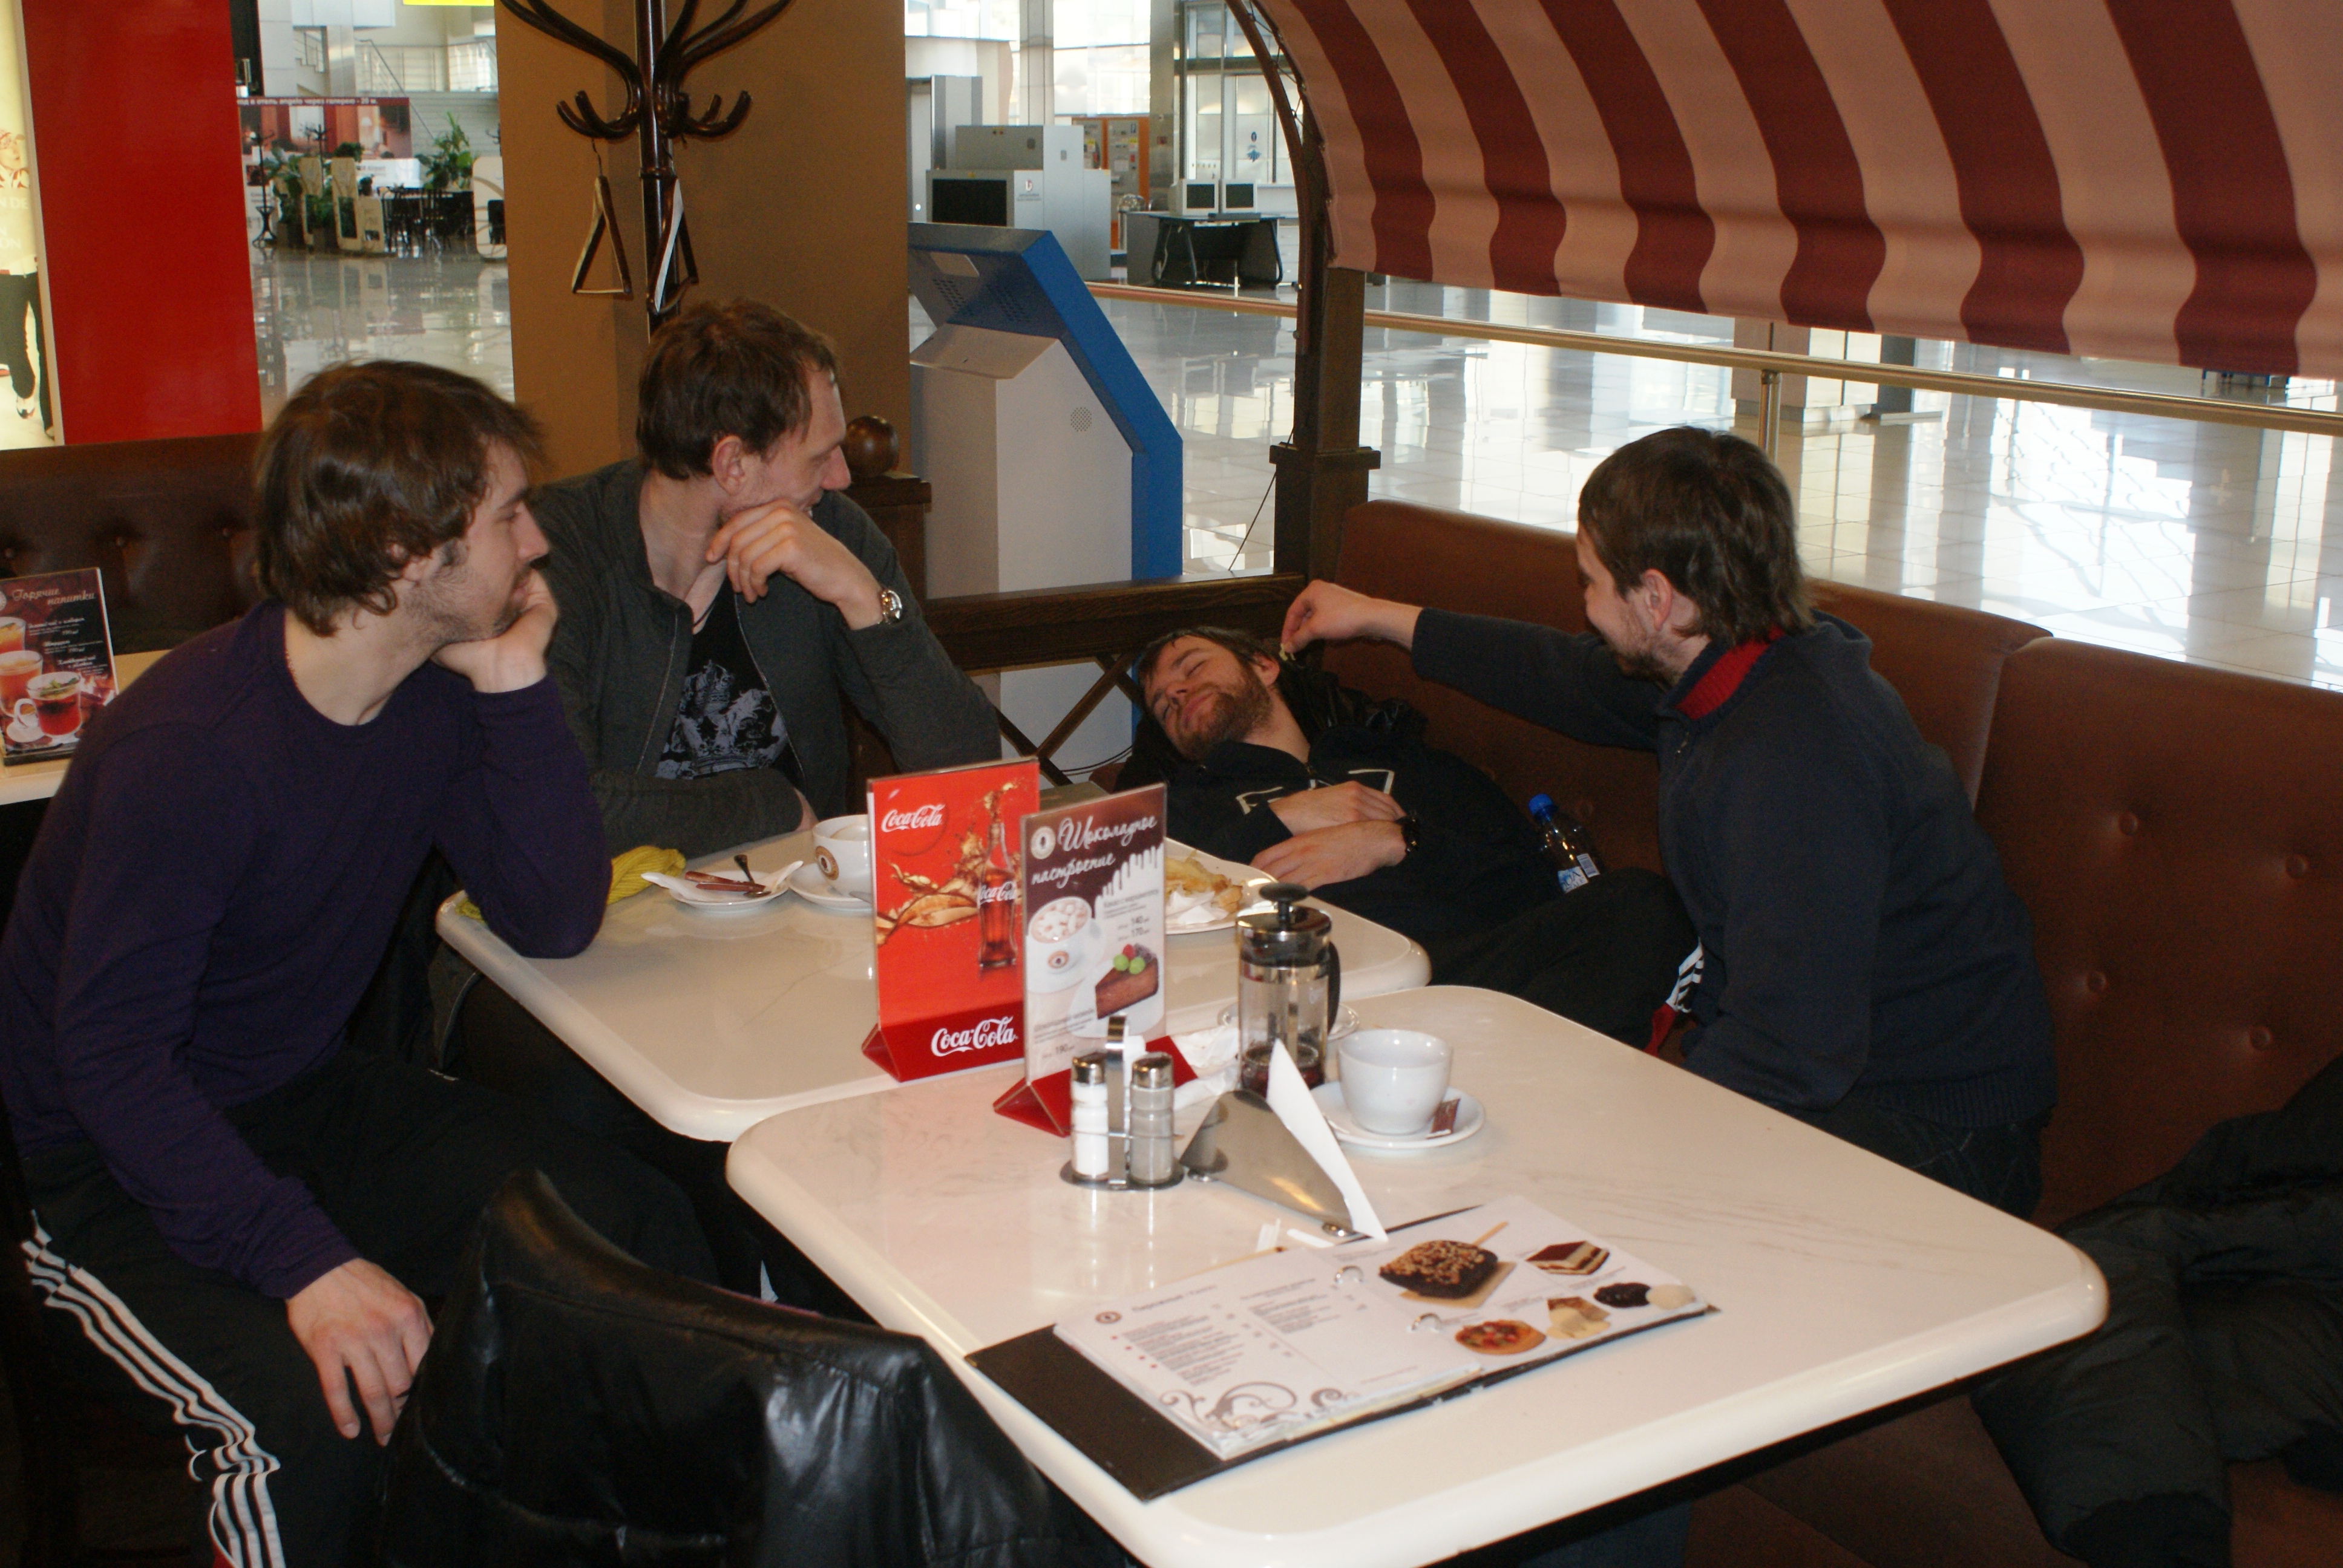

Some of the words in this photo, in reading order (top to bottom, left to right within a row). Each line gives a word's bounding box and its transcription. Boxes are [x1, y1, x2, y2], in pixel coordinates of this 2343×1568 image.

[47, 590, 96, 605] напитки
[881, 804, 945, 832] Coca-Cola
[1058, 815, 1158, 852] Шоколадное
[1031, 852, 1116, 889] настроение
[931, 1016, 1017, 1057] Coca-Cola
